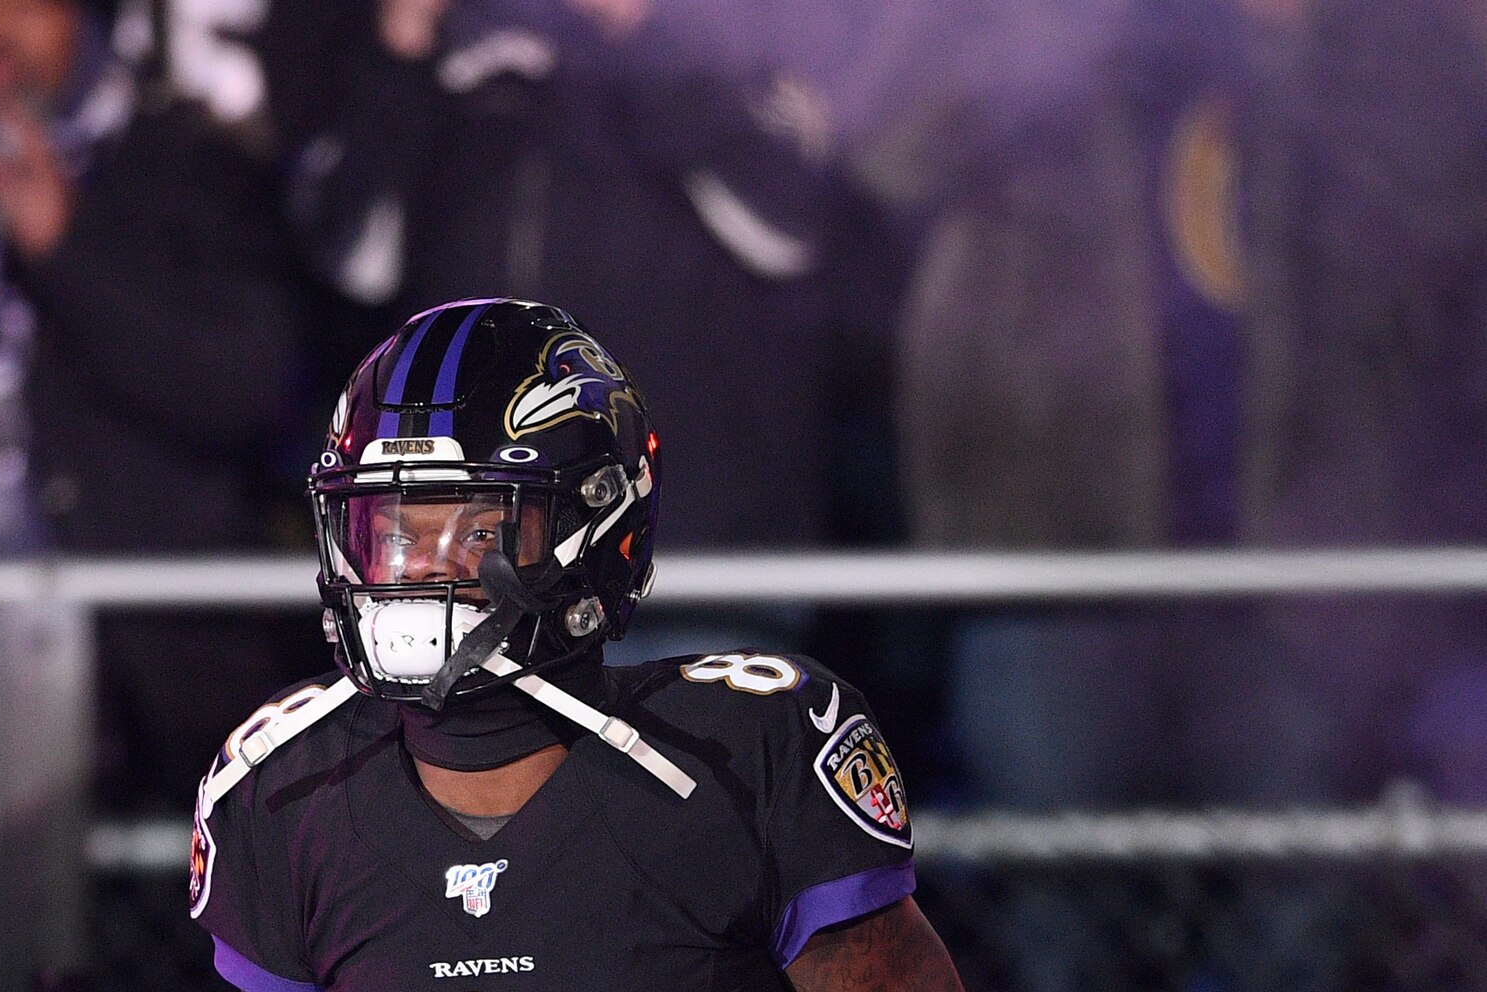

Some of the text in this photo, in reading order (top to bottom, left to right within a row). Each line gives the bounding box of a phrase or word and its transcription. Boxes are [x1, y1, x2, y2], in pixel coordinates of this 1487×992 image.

[381, 440, 435, 456] RAVENS
[679, 653, 809, 696] 8
[826, 722, 873, 771] RAVENS
[429, 956, 535, 978] RAVENS
